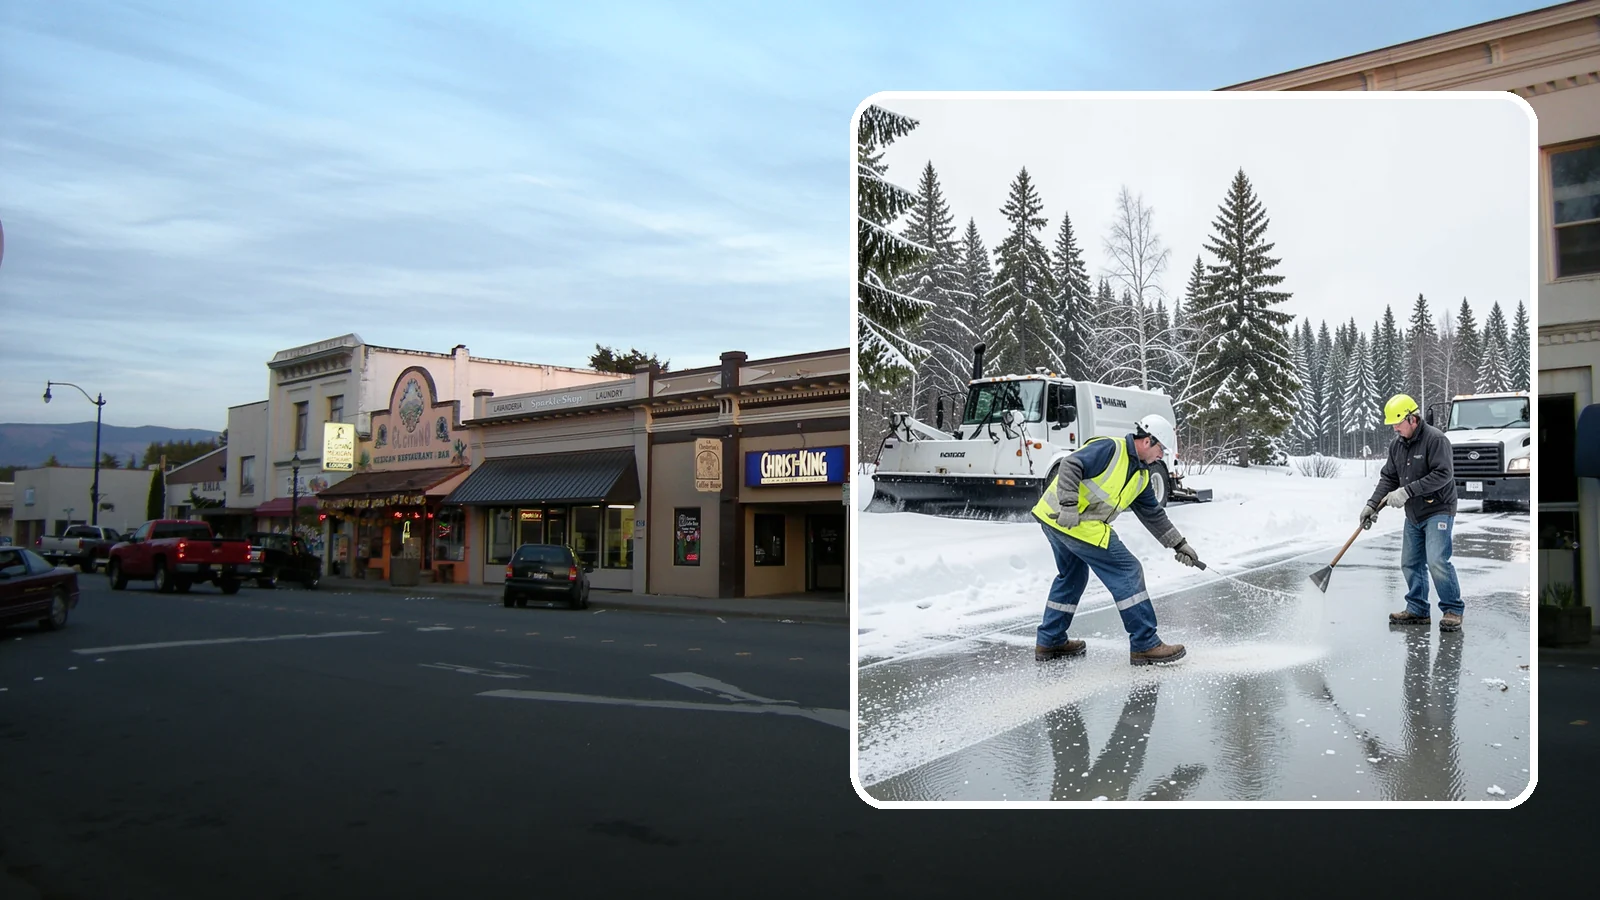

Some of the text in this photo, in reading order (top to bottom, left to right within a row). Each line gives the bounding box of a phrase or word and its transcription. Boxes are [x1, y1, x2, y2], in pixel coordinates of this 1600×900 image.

[562, 394, 582, 405] Shop
[595, 389, 624, 400] LAUNDRY
[493, 402, 523, 412] LAVANDERIA
[374, 450, 450, 464] MEXICAN RESTAURANT BAR
[799, 450, 828, 476] KING
